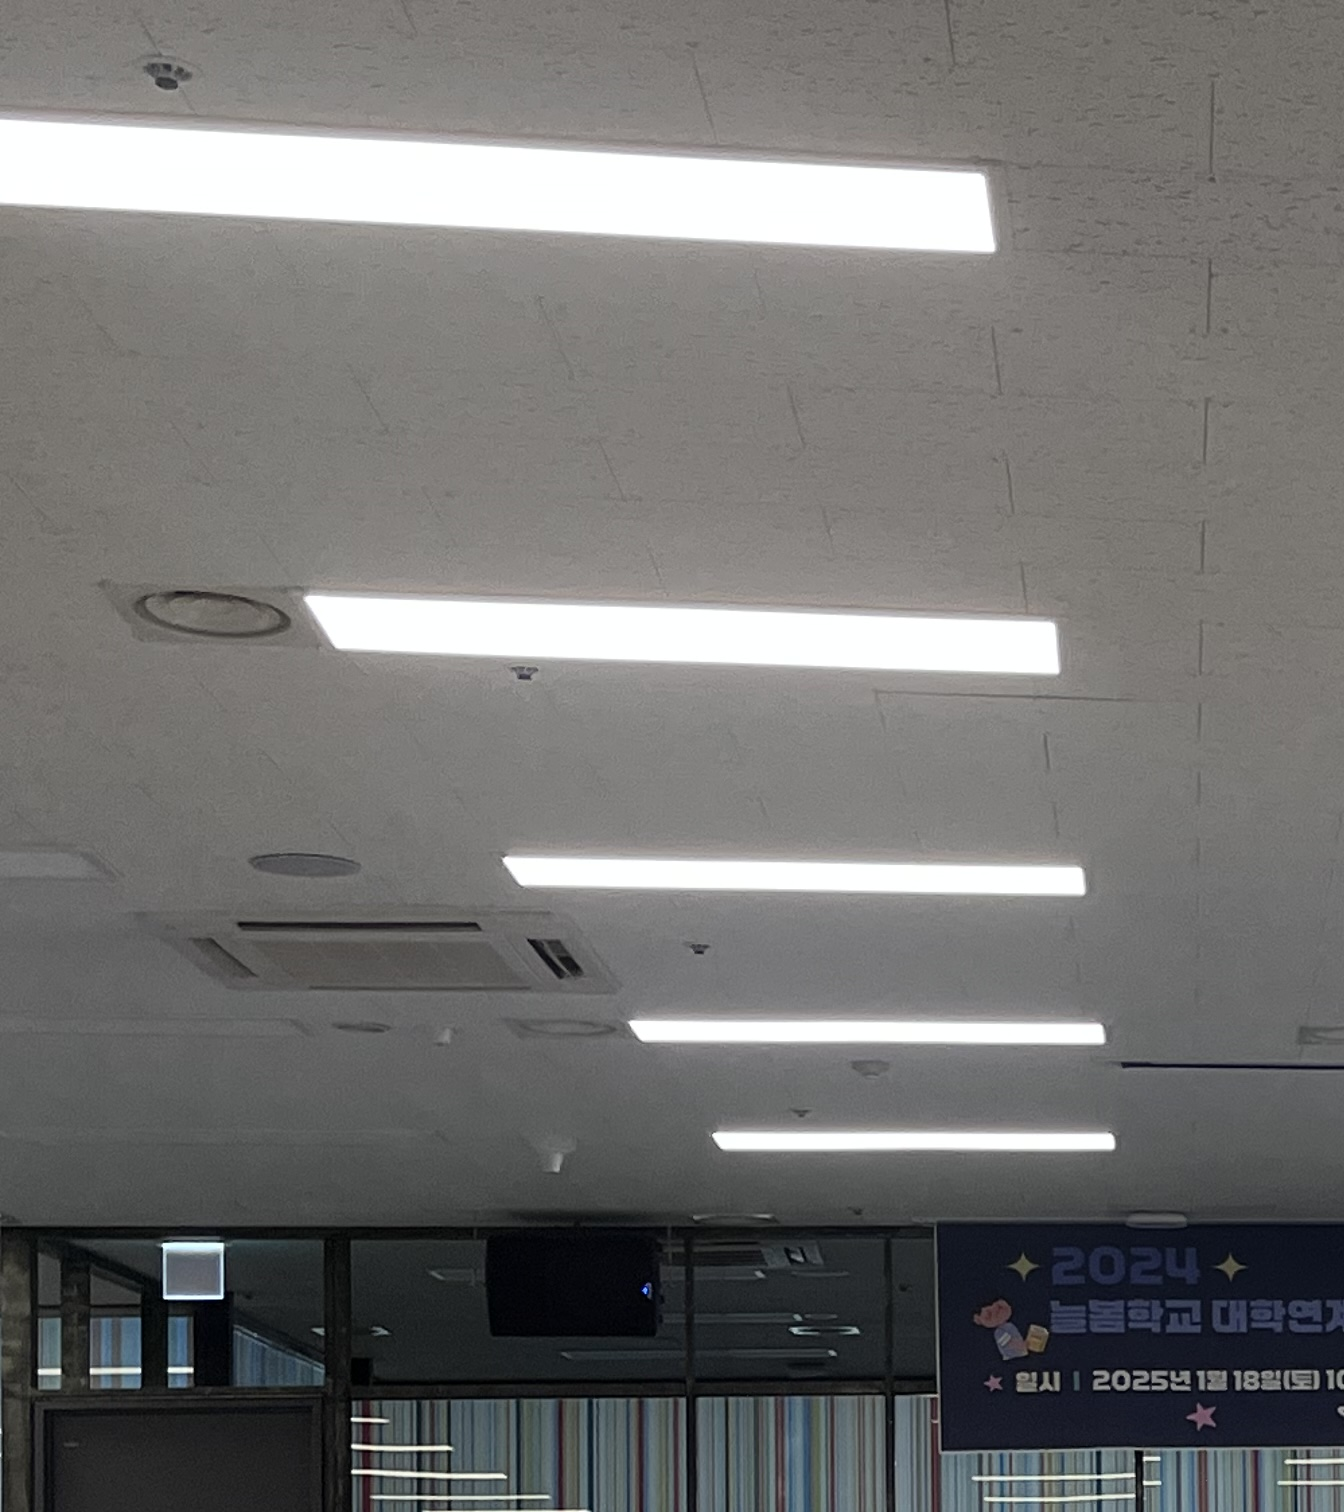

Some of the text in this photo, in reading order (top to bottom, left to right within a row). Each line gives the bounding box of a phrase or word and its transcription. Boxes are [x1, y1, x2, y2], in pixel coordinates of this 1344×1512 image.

[1052, 1247, 1200, 1285] 2024
[1049, 1300, 1201, 1334] 늘봄학교
[1015, 1371, 1061, 1393] 일시
[1092, 1370, 1192, 1392] 2025년
[1197, 1370, 1228, 1391] 1월
[1233, 1370, 1321, 1391] 18일(토)
